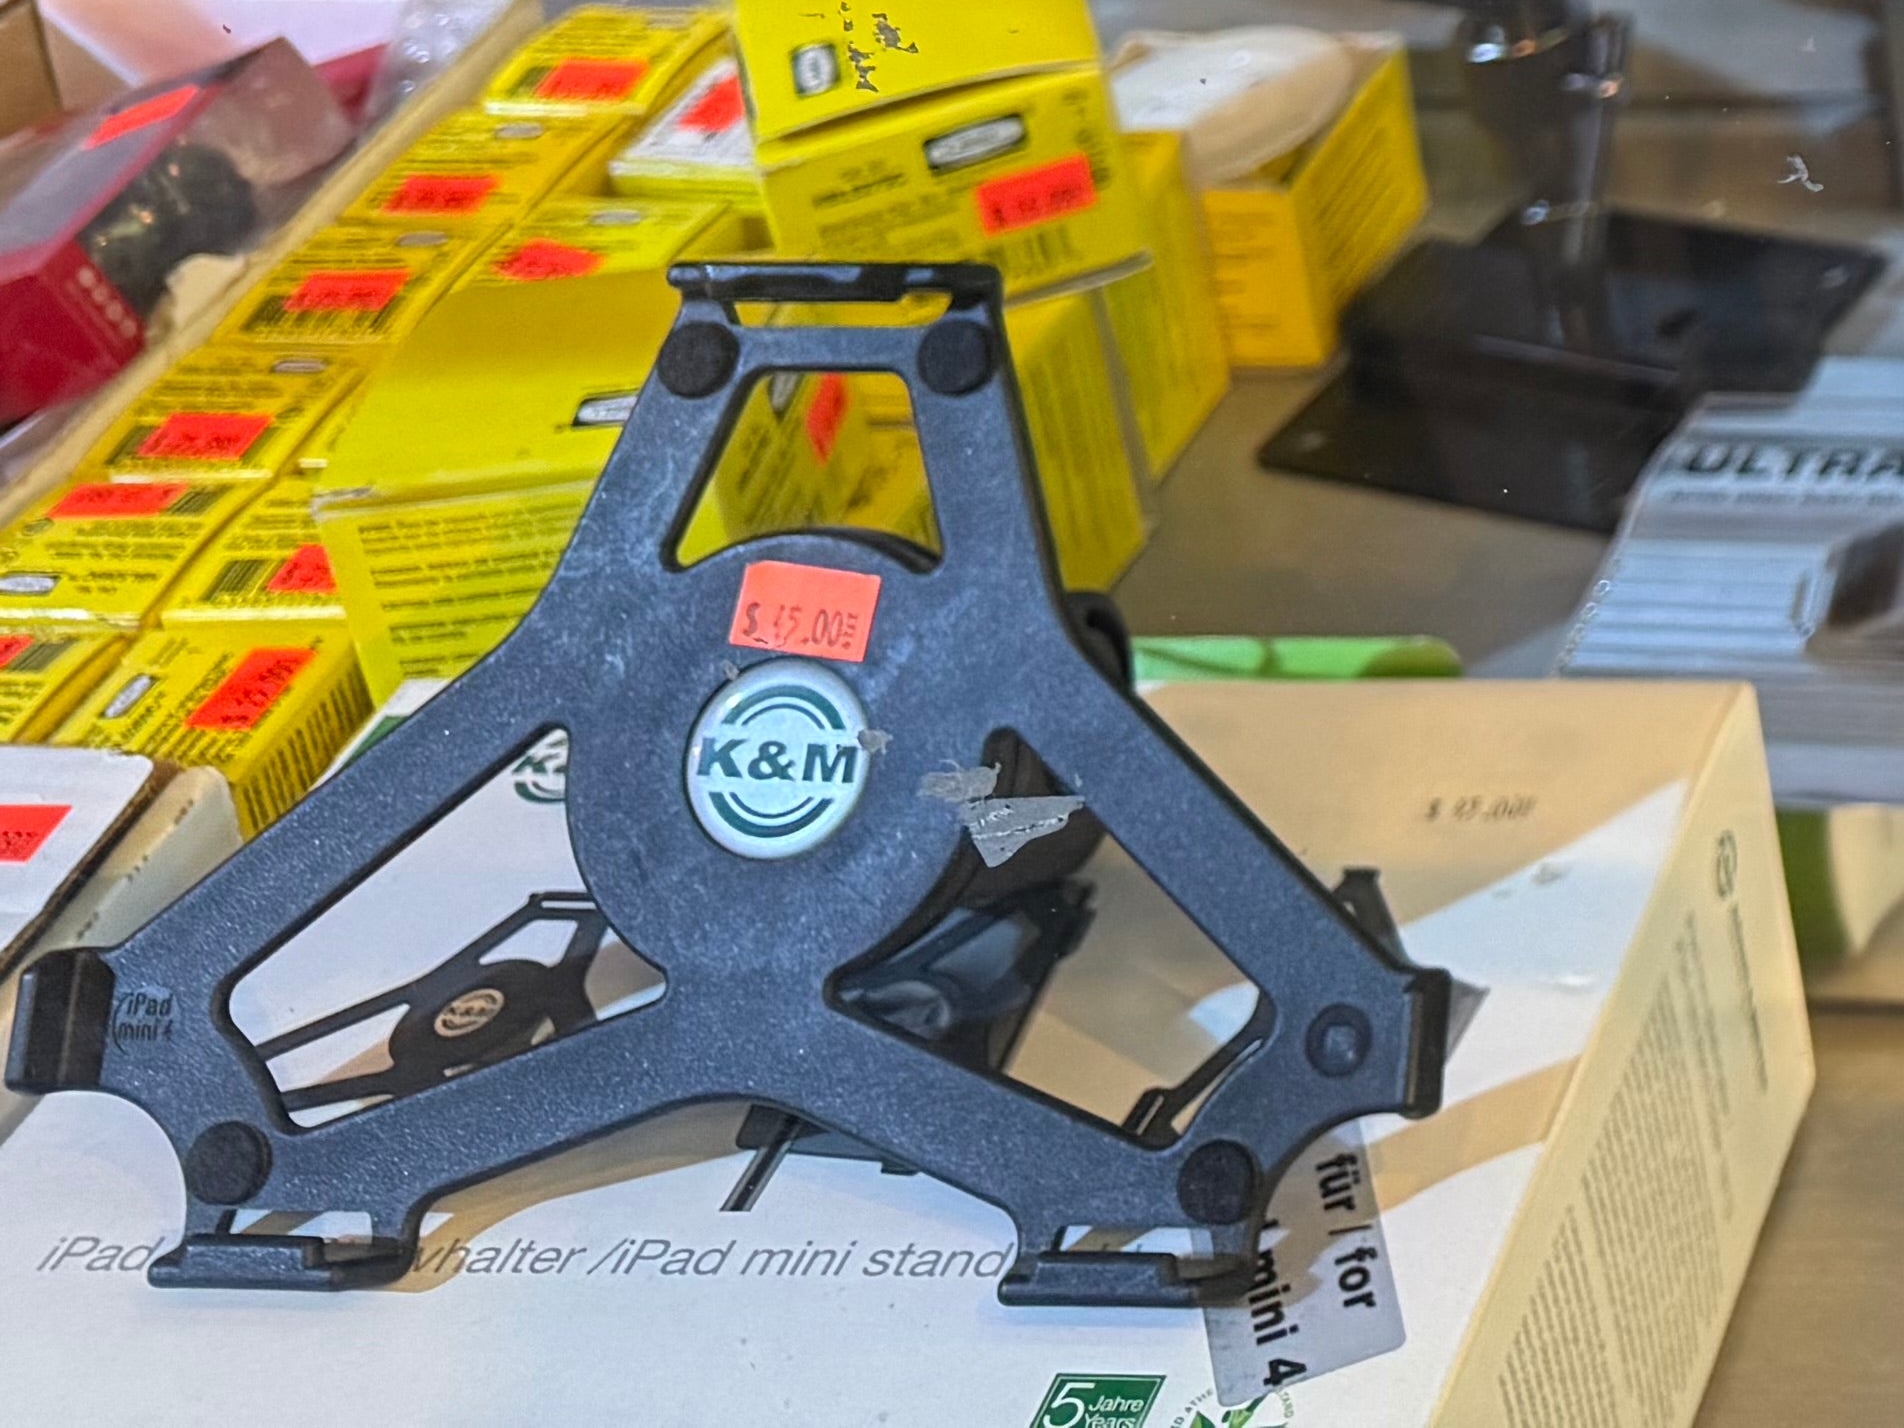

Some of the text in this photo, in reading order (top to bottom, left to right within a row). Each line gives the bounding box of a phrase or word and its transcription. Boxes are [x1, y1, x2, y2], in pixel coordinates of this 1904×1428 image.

[695, 736, 858, 785] K&M
[125, 991, 173, 1018] iPad
[1313, 1151, 1360, 1215] für
[36, 1234, 165, 1274] iPad
[748, 1238, 851, 1278] mini
[862, 1239, 1014, 1281] stand
[1333, 1245, 1378, 1310] for
[1247, 1248, 1308, 1387] mini 4
[1043, 1382, 1144, 1428] 5 Jahre
